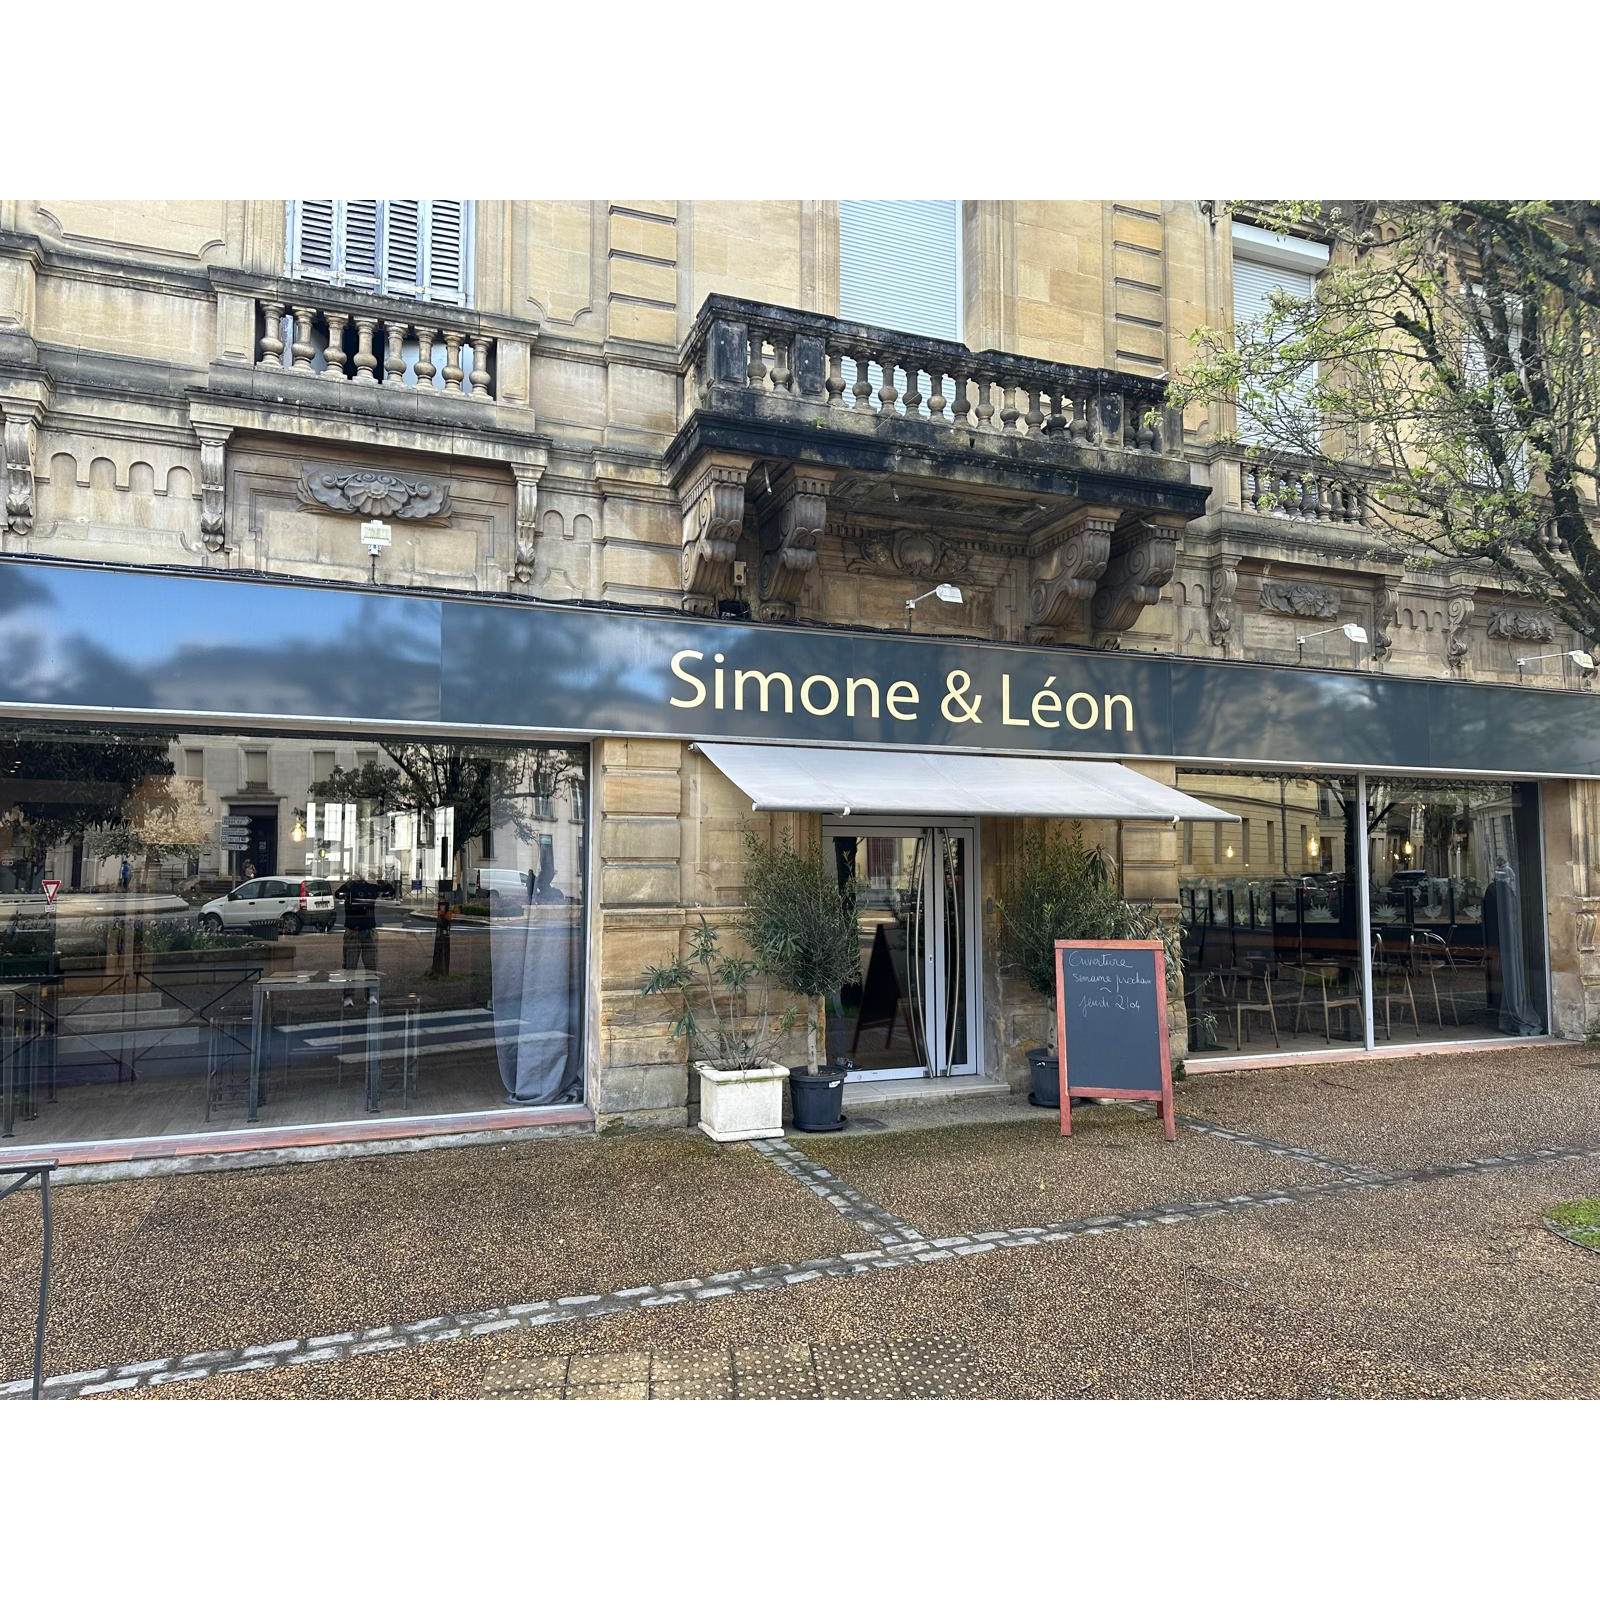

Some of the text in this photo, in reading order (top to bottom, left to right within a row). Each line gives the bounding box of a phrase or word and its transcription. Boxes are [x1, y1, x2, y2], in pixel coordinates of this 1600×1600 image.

[669, 649, 1133, 732] Simone & Léon
